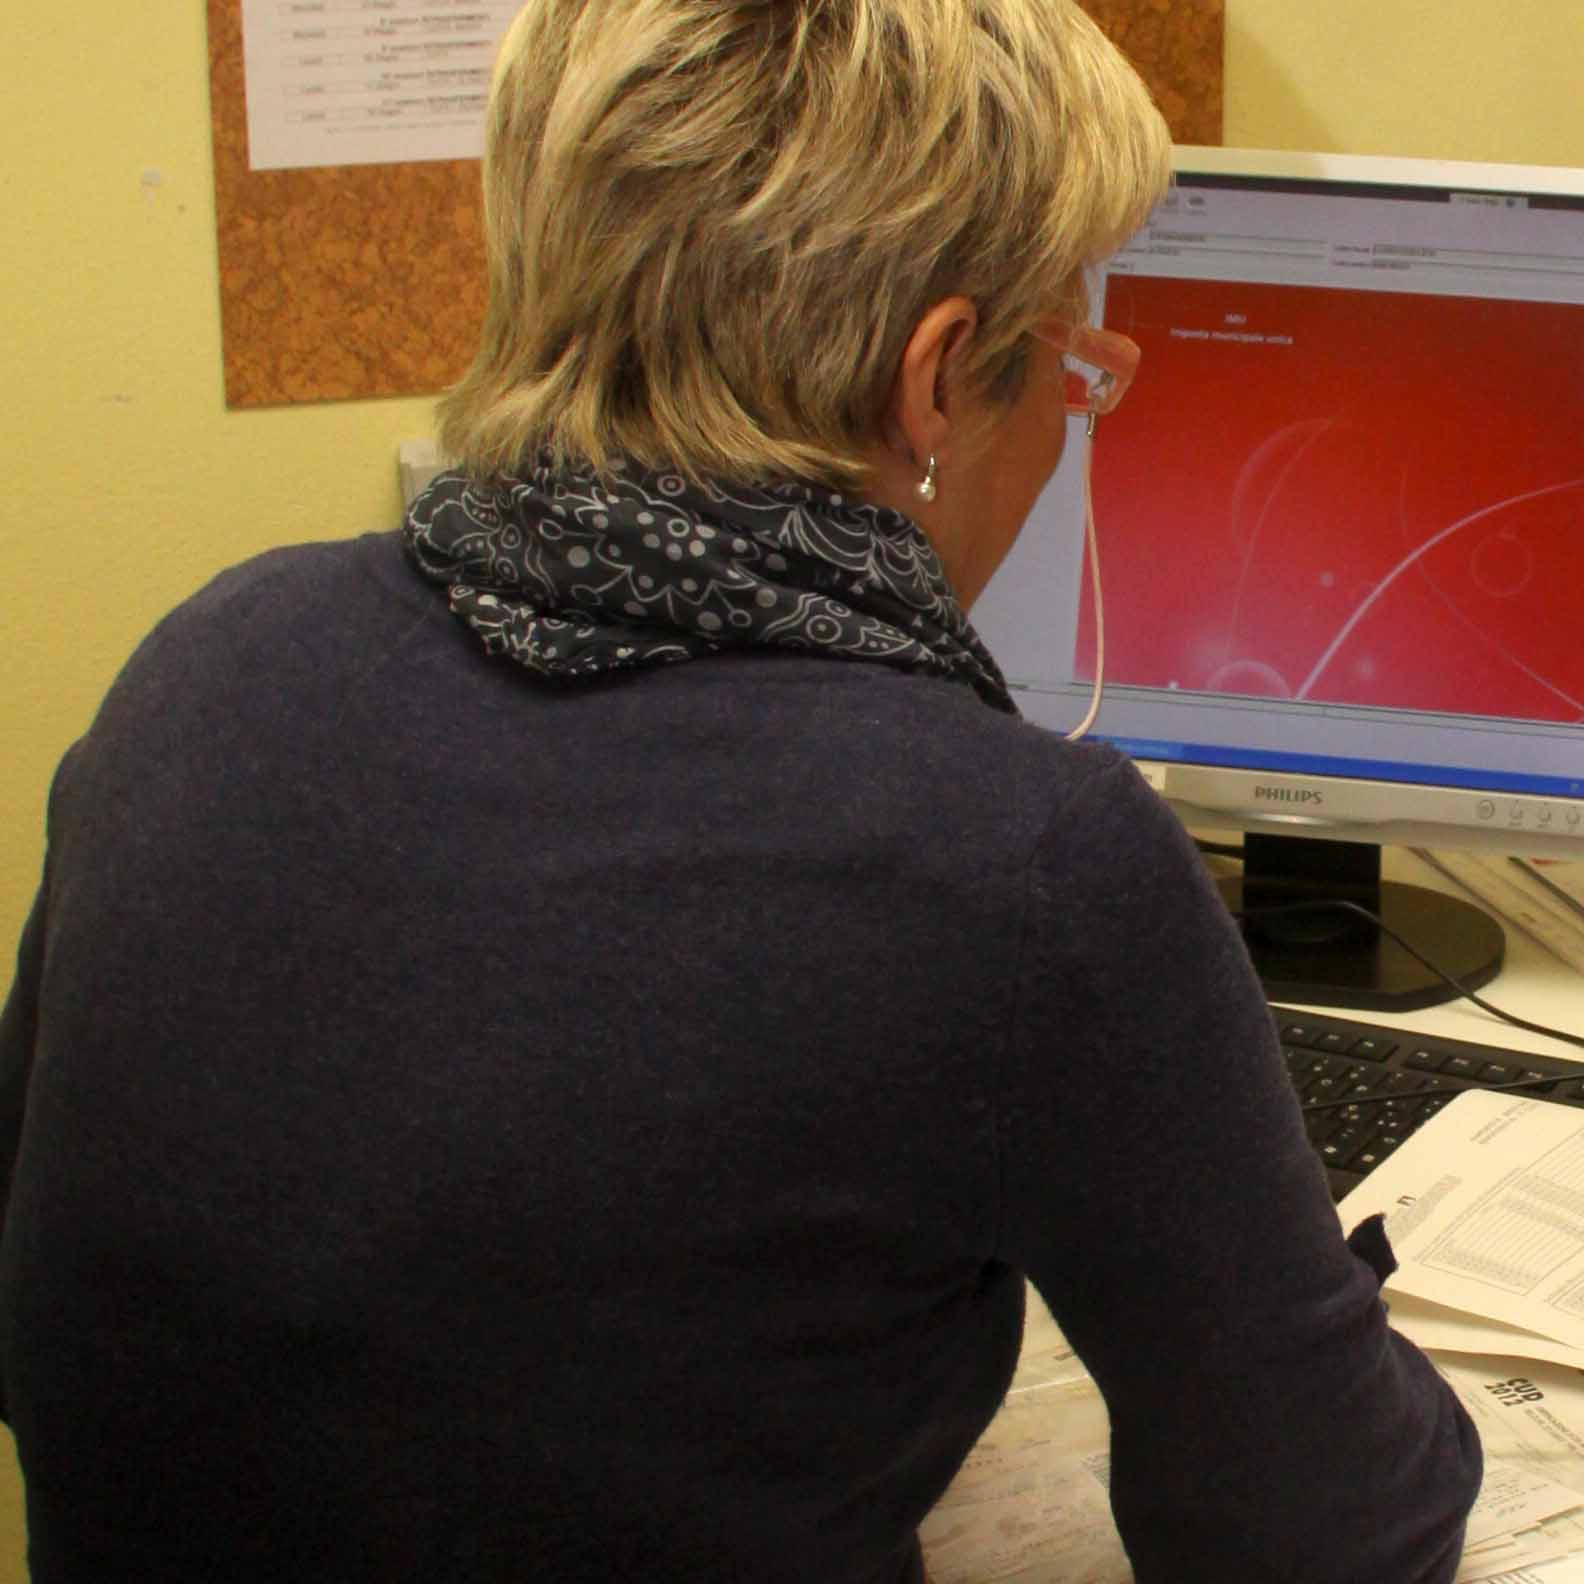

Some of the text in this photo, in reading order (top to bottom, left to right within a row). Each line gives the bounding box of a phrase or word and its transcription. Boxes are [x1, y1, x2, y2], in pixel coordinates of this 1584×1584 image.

[1254, 784, 1323, 805] PHILIPS
[1484, 1382, 1524, 1407] 2012
[1507, 1377, 1544, 1403] CUD
